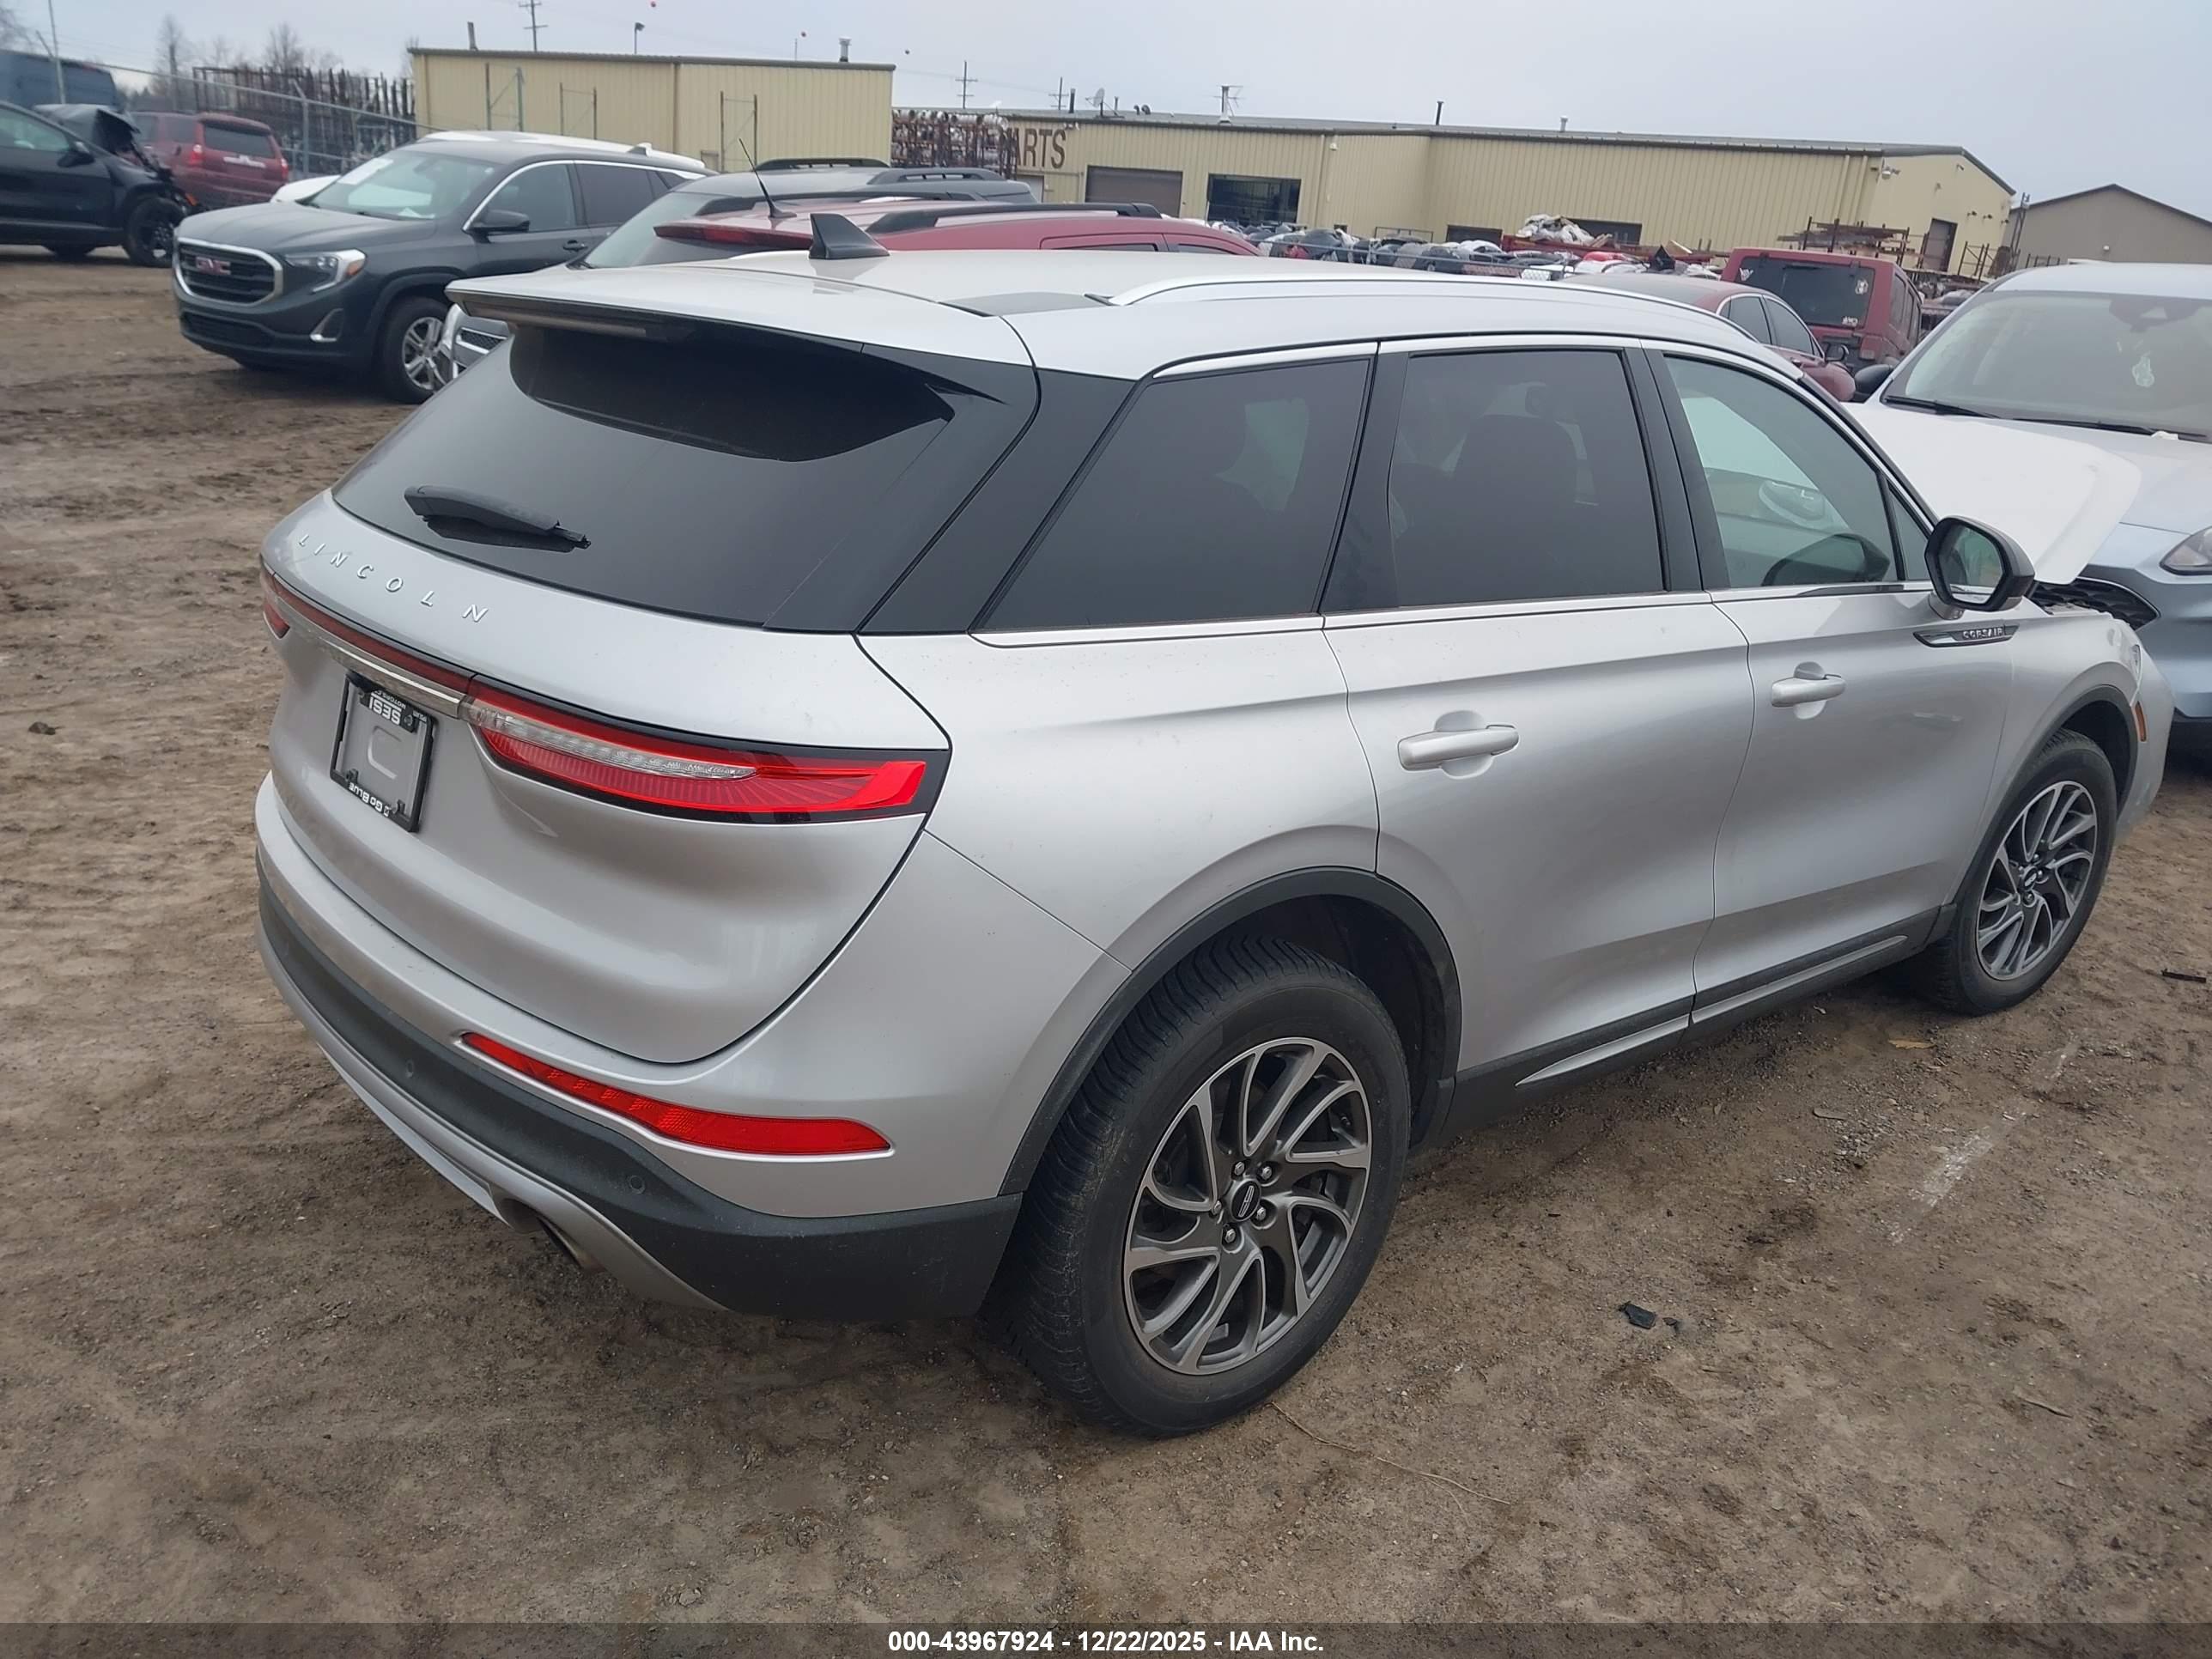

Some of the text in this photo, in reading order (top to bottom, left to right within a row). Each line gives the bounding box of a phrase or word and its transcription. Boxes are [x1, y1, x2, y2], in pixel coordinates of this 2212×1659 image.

[195, 256, 231, 276] GMC
[298, 534, 489, 623] LINCOLN
[1962, 627, 2003, 639] CORSAIR
[368, 696, 402, 726] SESI
